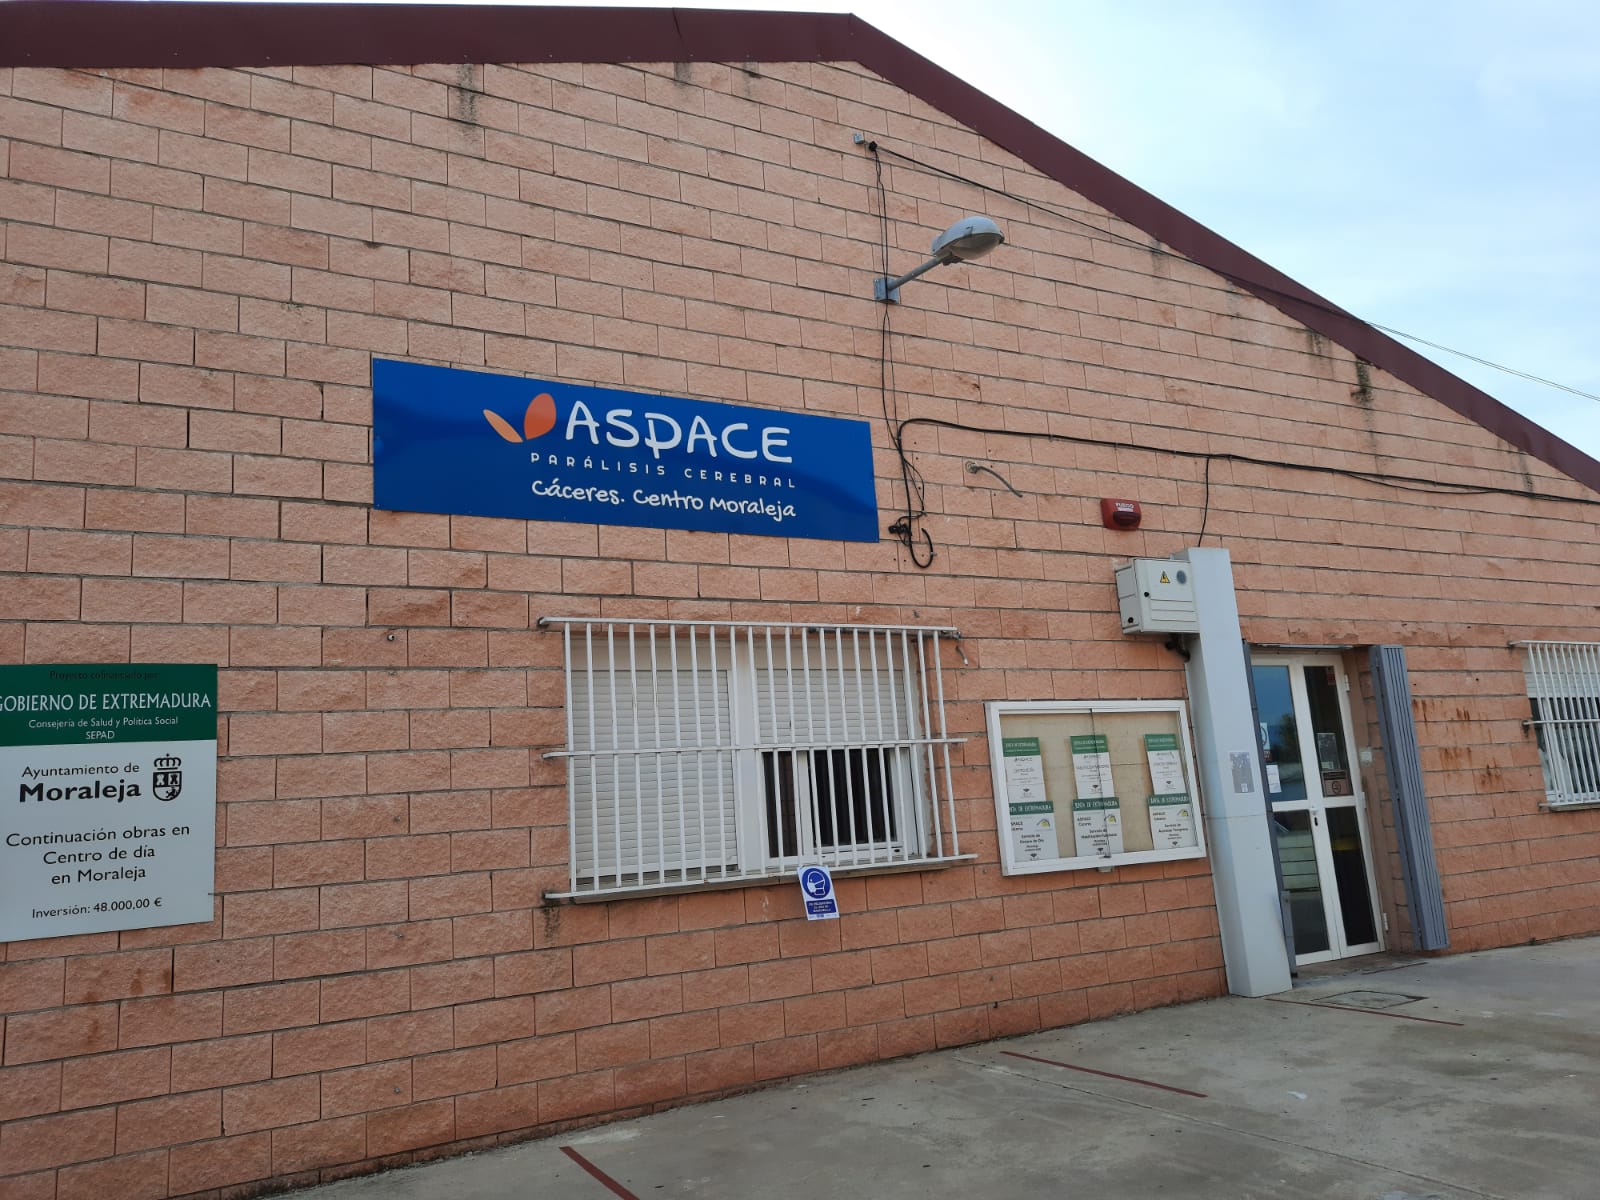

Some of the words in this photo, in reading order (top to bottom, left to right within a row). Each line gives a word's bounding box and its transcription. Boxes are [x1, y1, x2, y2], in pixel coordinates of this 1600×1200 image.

[565, 400, 793, 463] ASPACE
[530, 452, 665, 475] PARÁLISIS
[684, 467, 796, 488] CEREBRAL
[531, 478, 625, 505] Cáceres.
[633, 489, 704, 510] Centro
[709, 498, 796, 522] Moraleja
[0, 695, 74, 712] OBIERNO
[78, 694, 97, 710] DE
[102, 692, 212, 710] EXTREMADURA
[28, 718, 75, 730] Consejería
[77, 718, 89, 727] de
[90, 717, 113, 727] Salud
[115, 720, 121, 728] y
[123, 716, 152, 726] Política
[154, 716, 179, 725] Social
[85, 730, 115, 740] SEPAD
[21, 764, 119, 780] Ayuntamiento
[123, 762, 140, 773] de
[19, 779, 142, 803] Moraleja
[6, 828, 117, 847] Continuación
[122, 826, 166, 839] obras
[171, 825, 190, 836] en
[43, 851, 102, 865] Centro
[108, 847, 128, 860] de
[133, 845, 156, 858] día
[51, 873, 71, 885] en
[77, 866, 146, 883] Moraleja
[32, 904, 91, 919] Inversión:
[154, 897, 163, 908] €
